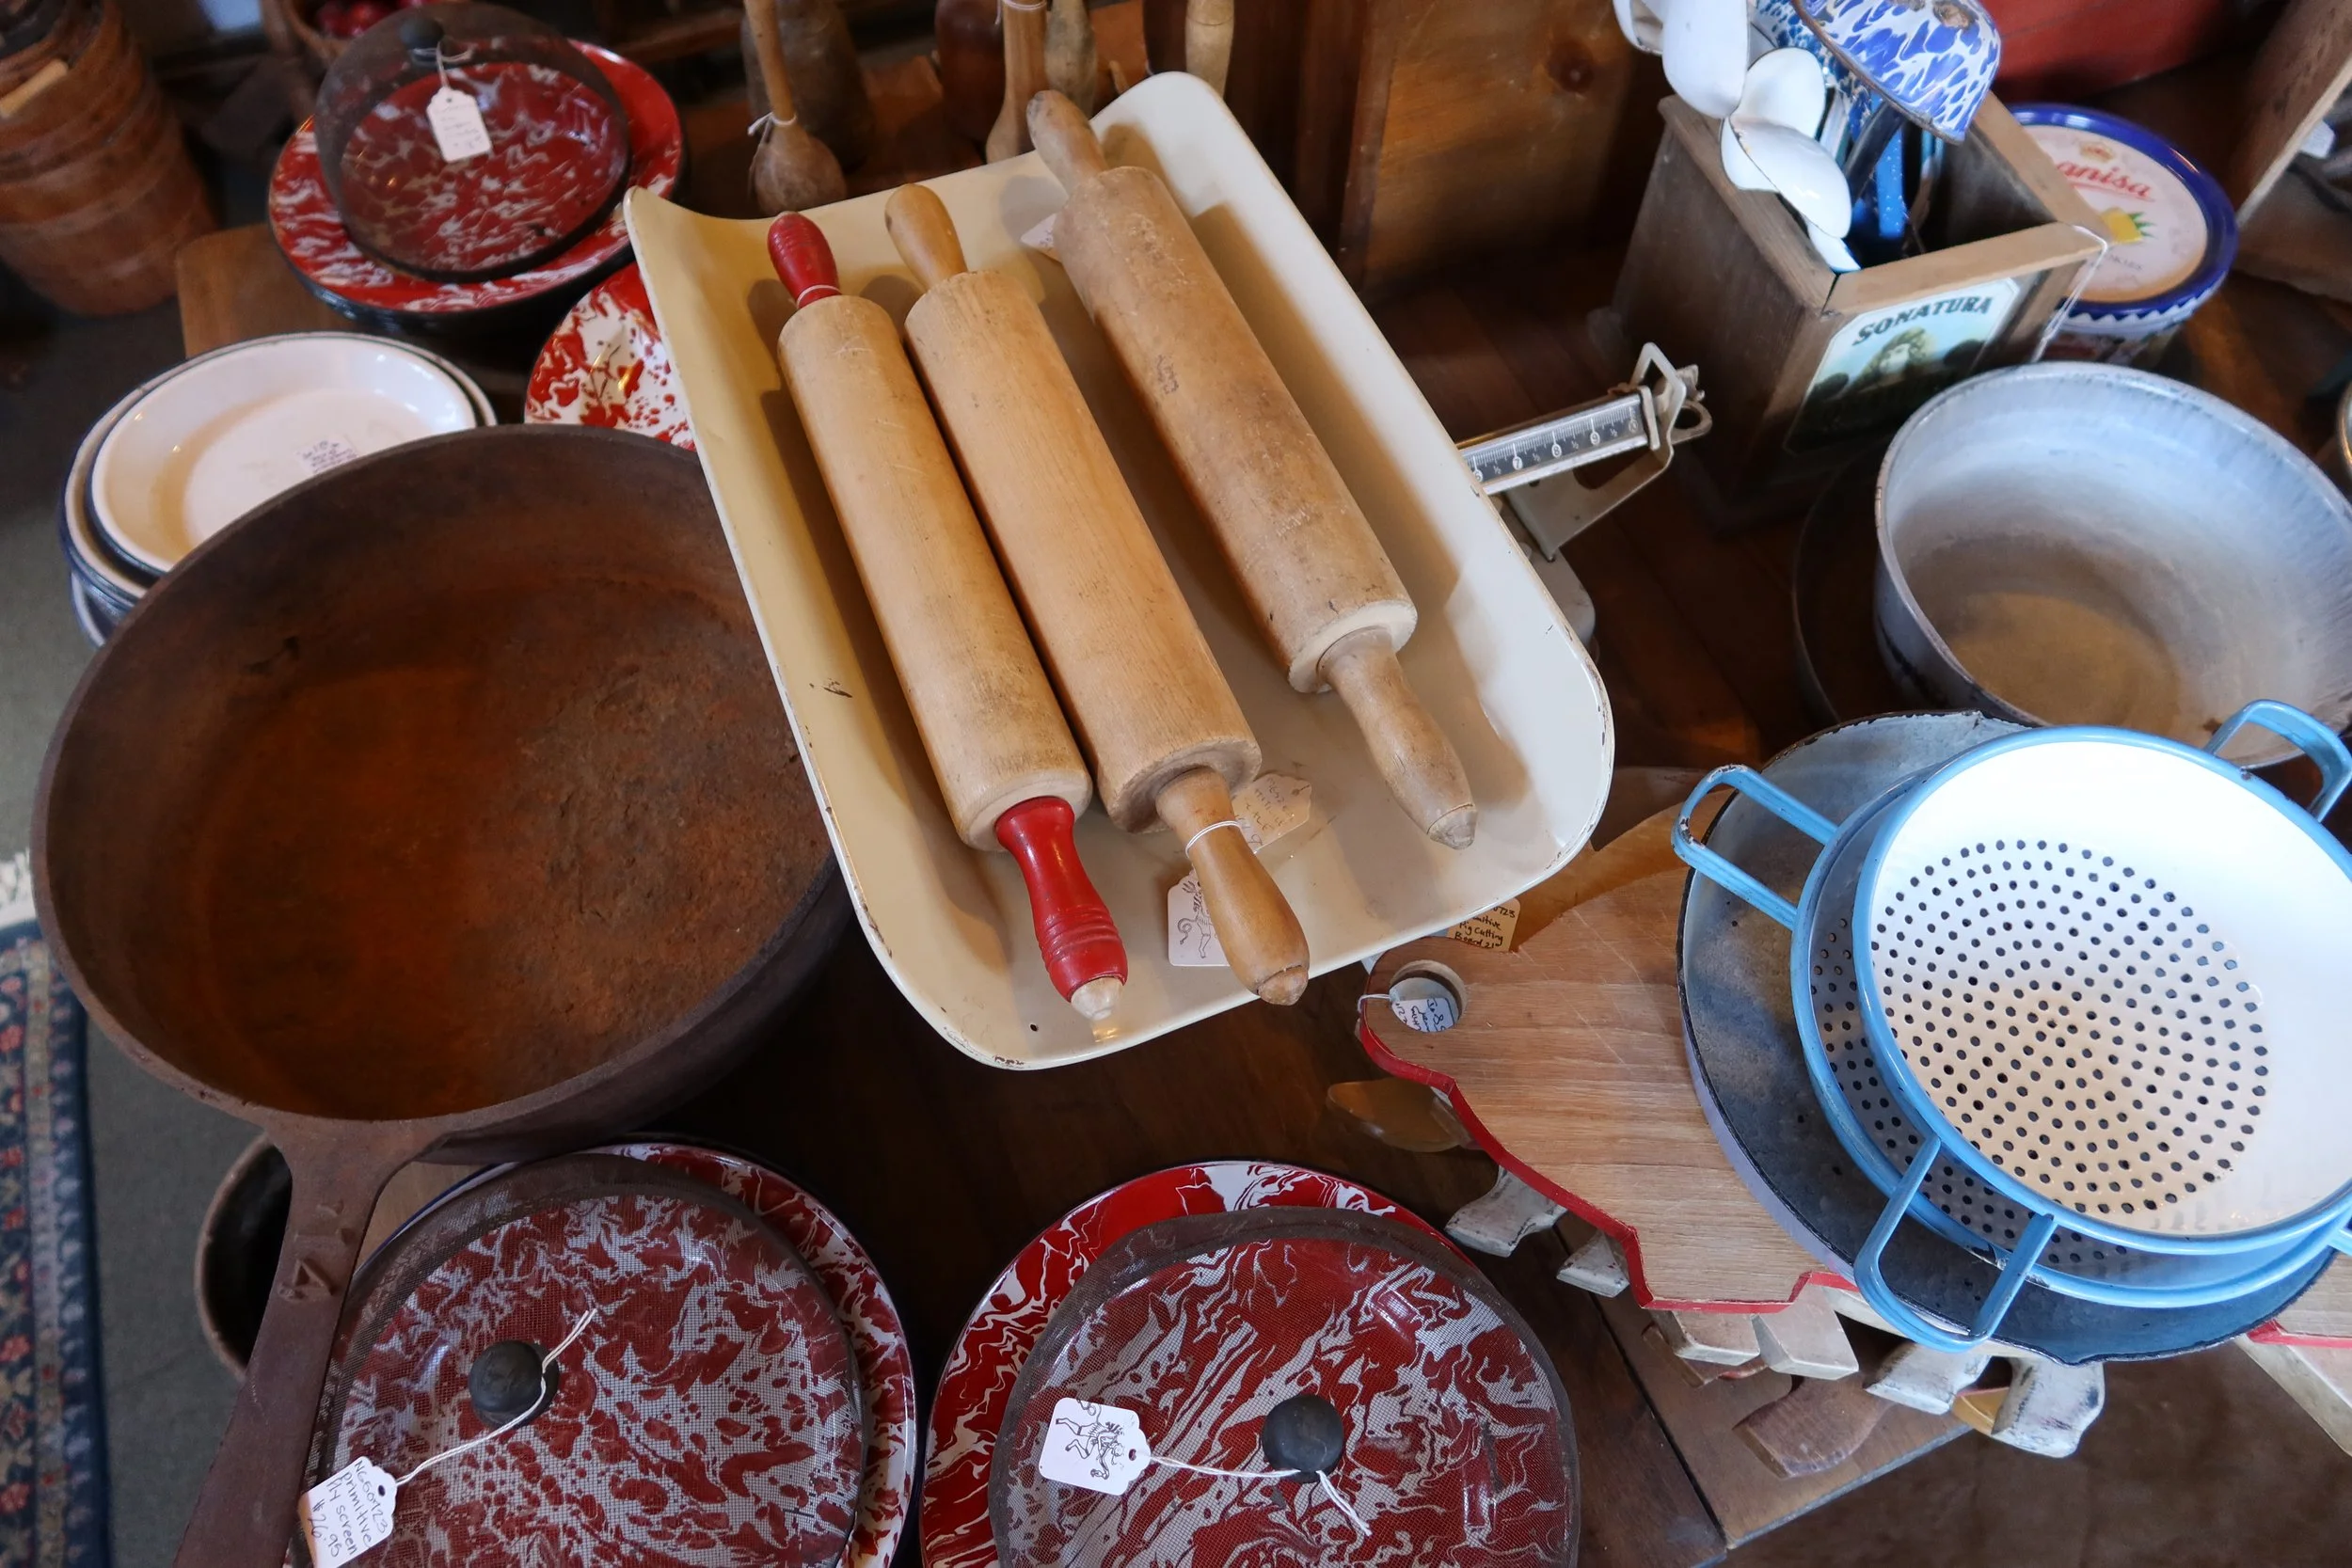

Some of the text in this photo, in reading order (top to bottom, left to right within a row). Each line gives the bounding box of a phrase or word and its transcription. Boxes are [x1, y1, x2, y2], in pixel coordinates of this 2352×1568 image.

[2057, 160, 2151, 198] anisa
[1851, 296, 1994, 346] SONATURA
[1474, 927, 1503, 946] Cutting
[335, 1505, 359, 1556] screen
